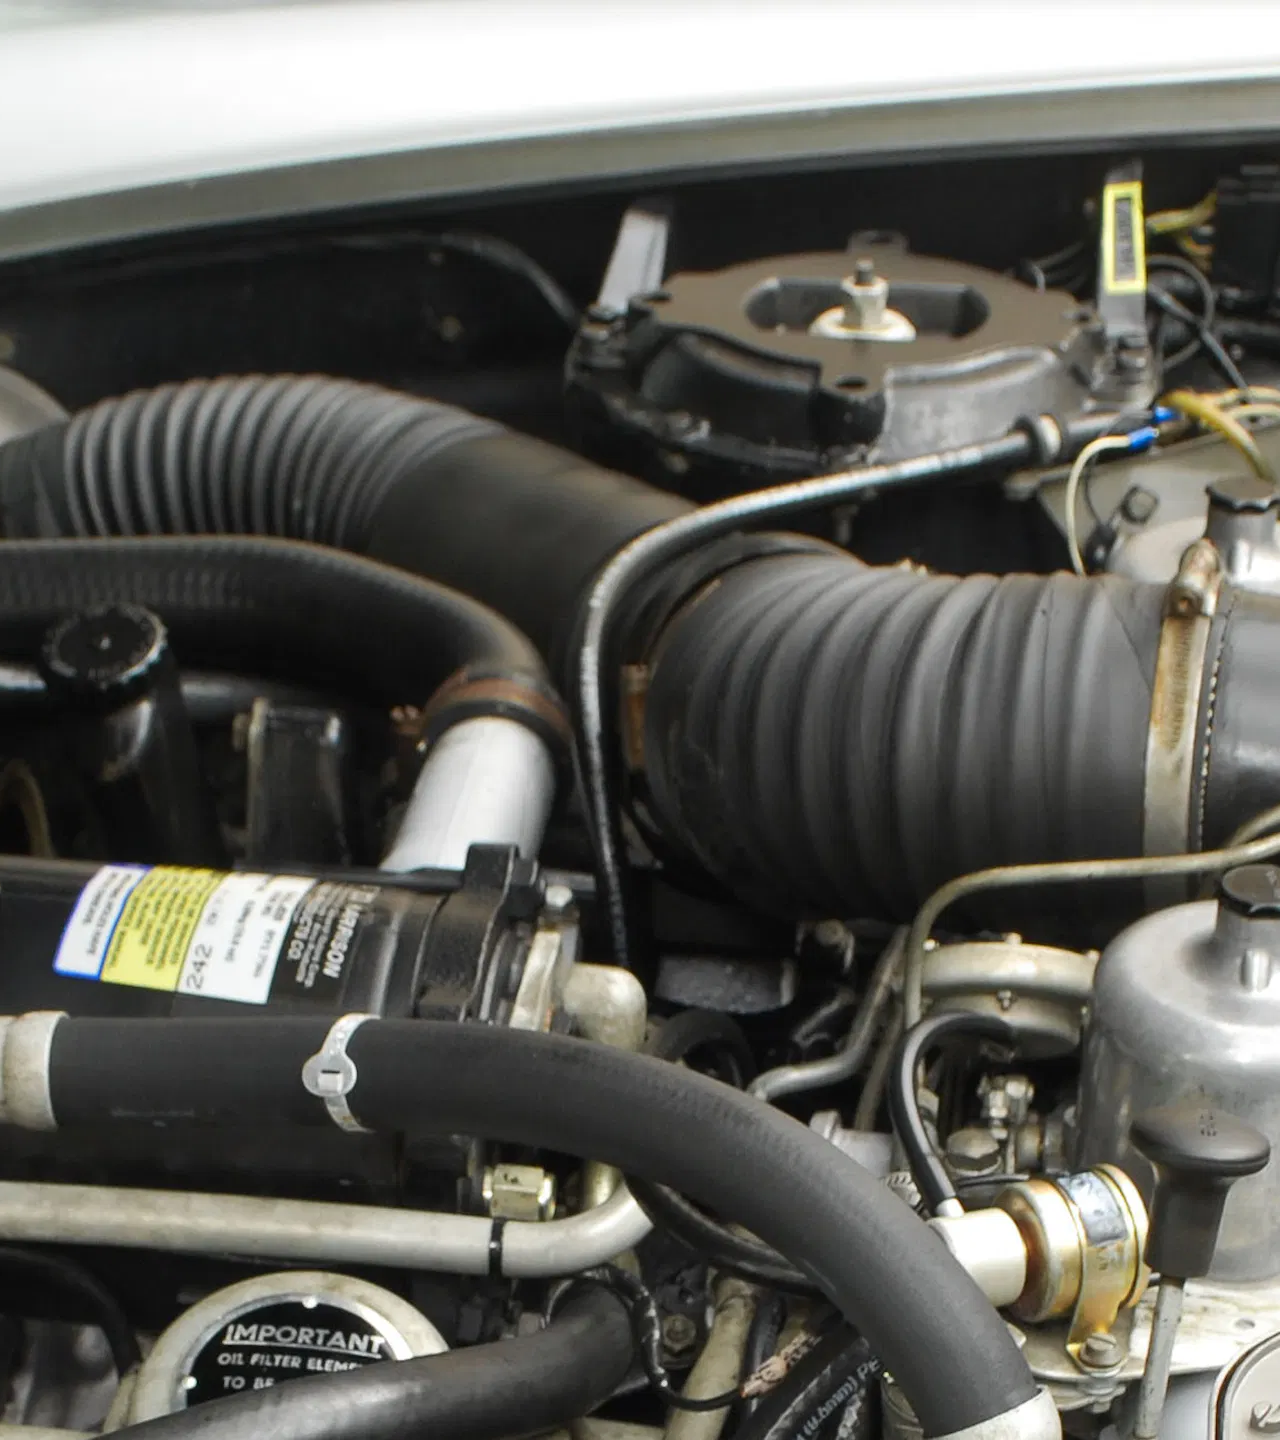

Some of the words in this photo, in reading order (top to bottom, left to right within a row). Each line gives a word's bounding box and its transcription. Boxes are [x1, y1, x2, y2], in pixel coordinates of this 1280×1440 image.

[186, 943, 214, 990] 242
[225, 1323, 386, 1353] IMPORTANT
[218, 1352, 244, 1367] OIL
[250, 1353, 302, 1369] FILTER
[223, 1375, 246, 1390] TO
